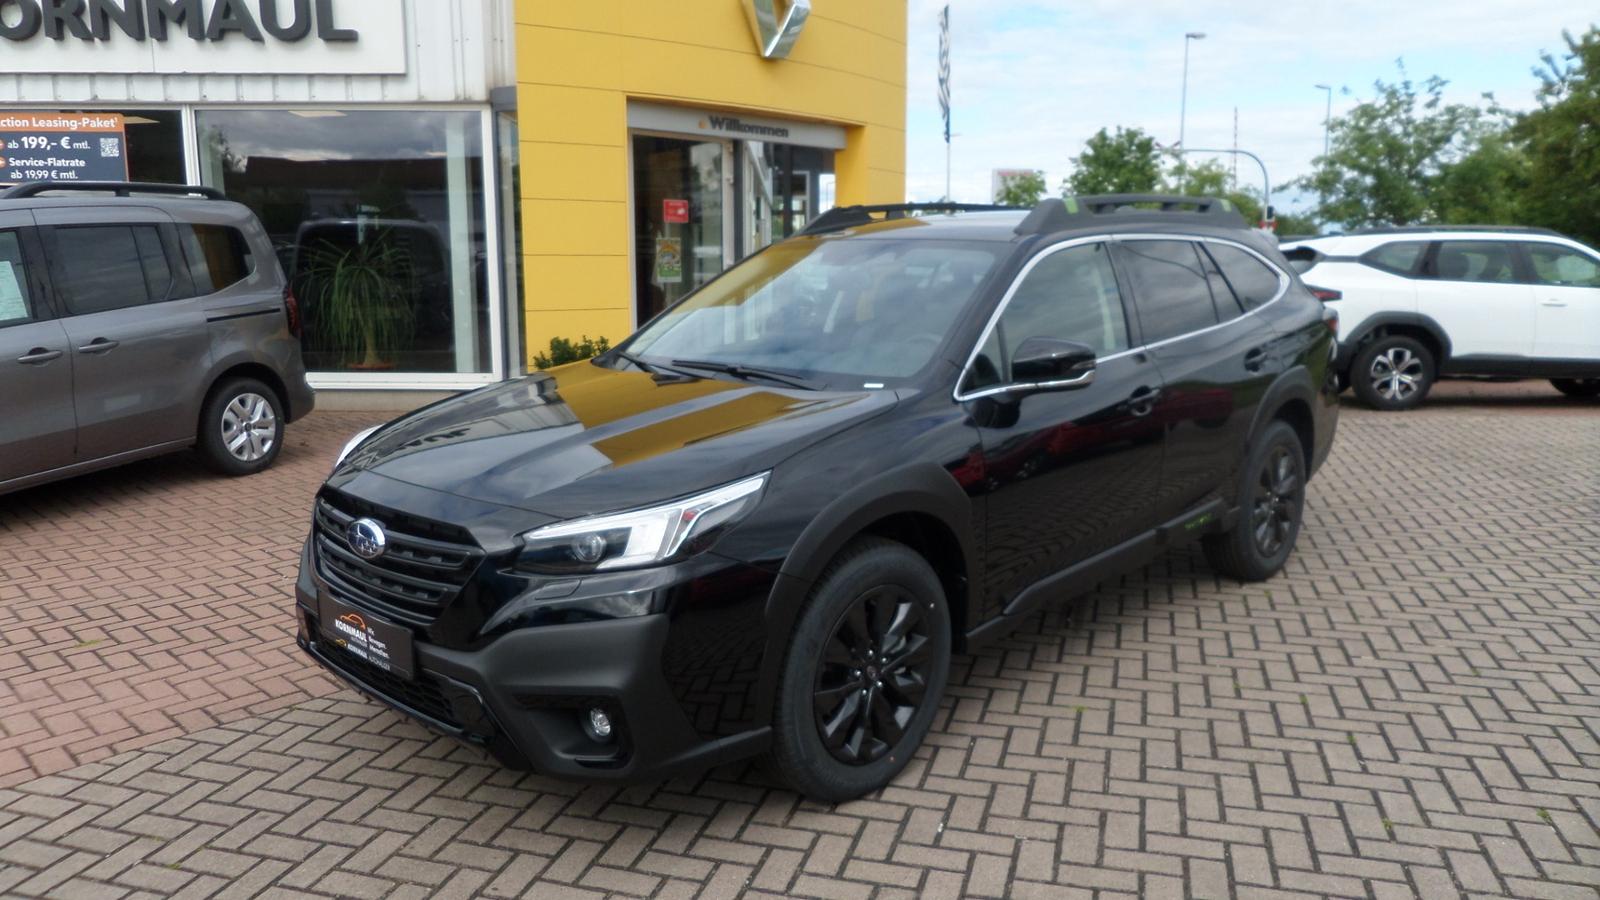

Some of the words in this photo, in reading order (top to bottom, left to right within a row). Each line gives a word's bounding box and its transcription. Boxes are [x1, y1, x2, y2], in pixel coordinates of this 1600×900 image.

[708, 115, 789, 138] Willkommen
[7, 139, 20, 149] ab
[21, 136, 57, 150] 199,-
[60, 136, 71, 149] €
[73, 140, 91, 149] mtl.
[9, 157, 86, 167] Service-Flatrate
[10, 170, 22, 179] ab
[25, 170, 49, 180] 19,99
[51, 170, 58, 179] €
[60, 170, 78, 179] mtl.
[335, 618, 368, 642] KORNMAUL
